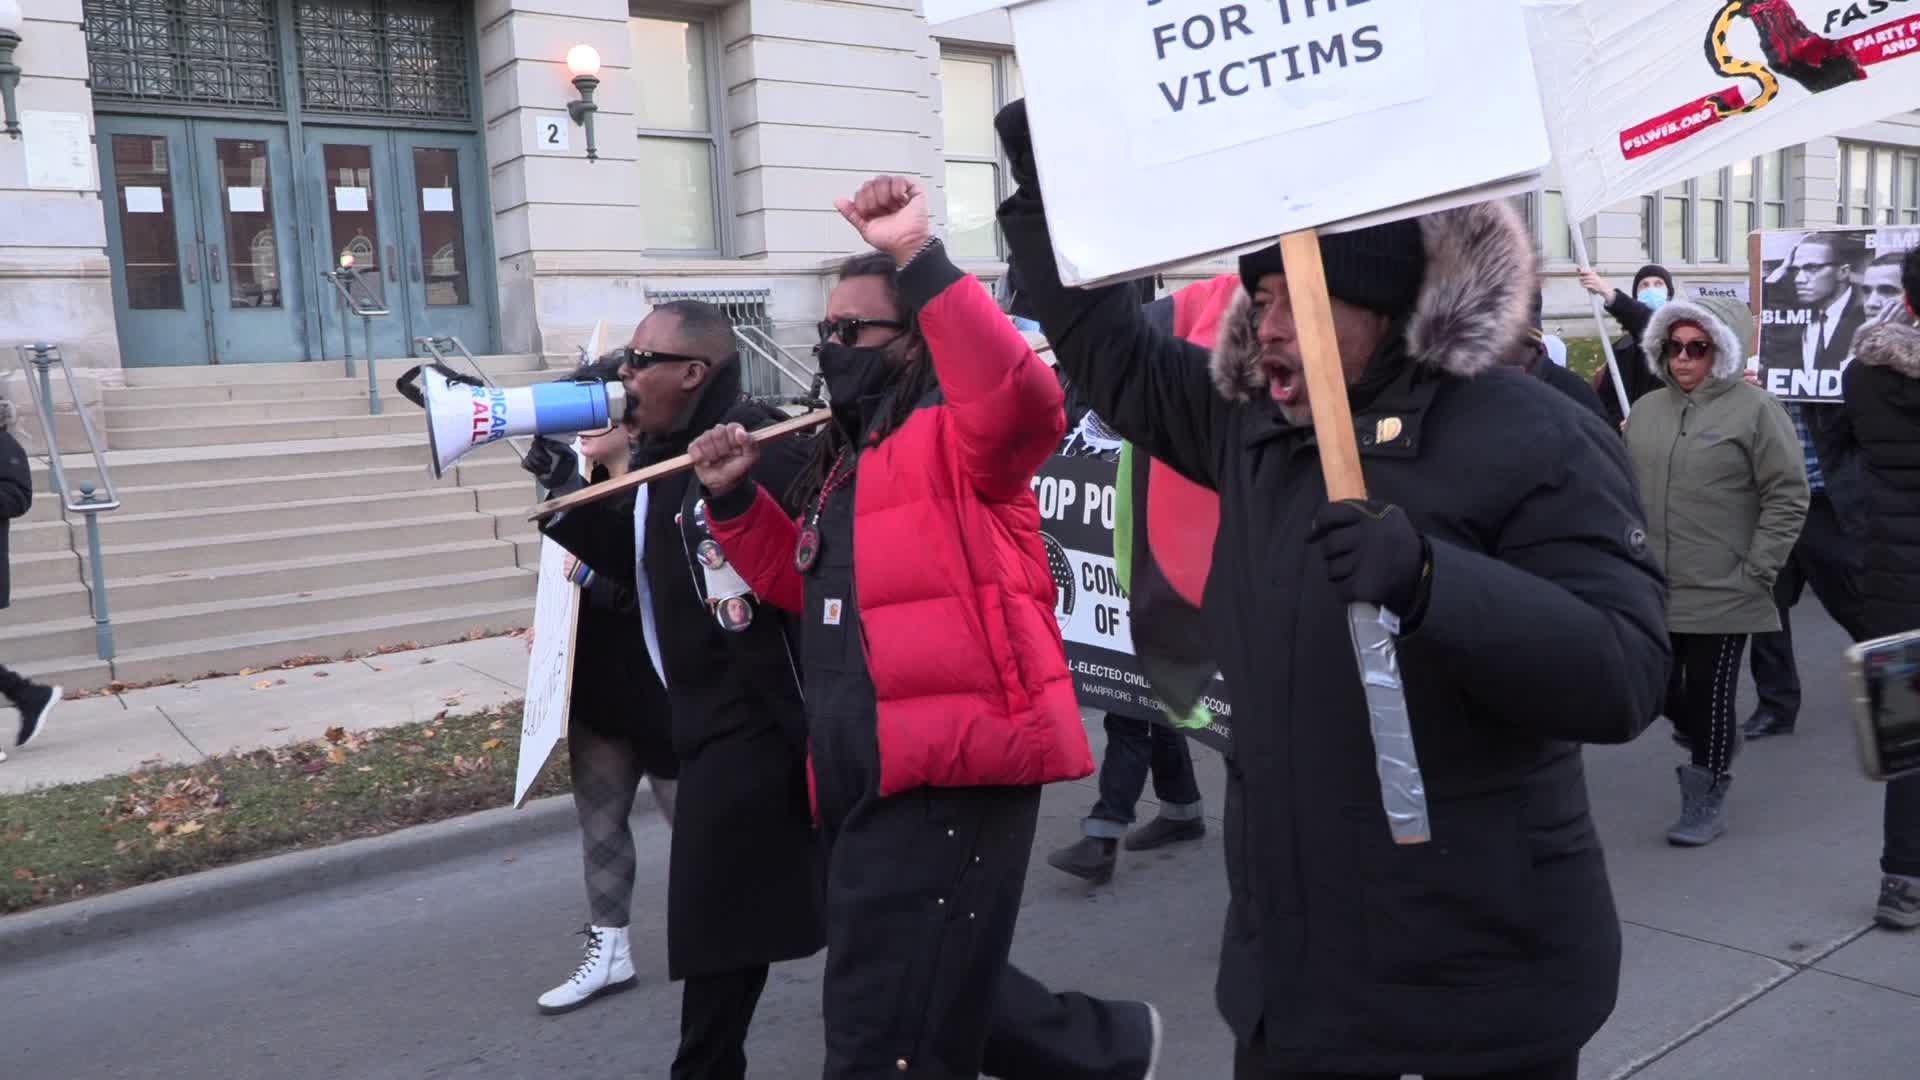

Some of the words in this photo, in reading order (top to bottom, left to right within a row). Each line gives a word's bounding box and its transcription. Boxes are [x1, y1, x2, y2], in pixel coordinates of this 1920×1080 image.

[1153, 4, 1254, 60] FOR
[1853, 24, 1905, 51] PARTY
[1881, 37, 1918, 56] AND
[1158, 25, 1383, 112] VICTIMS
[547, 123, 559, 144] 2
[1761, 309, 1812, 324] BLM!
[1767, 368, 1843, 397] END
[472, 401, 489, 443] ALL
[1094, 603, 1120, 636] OF
